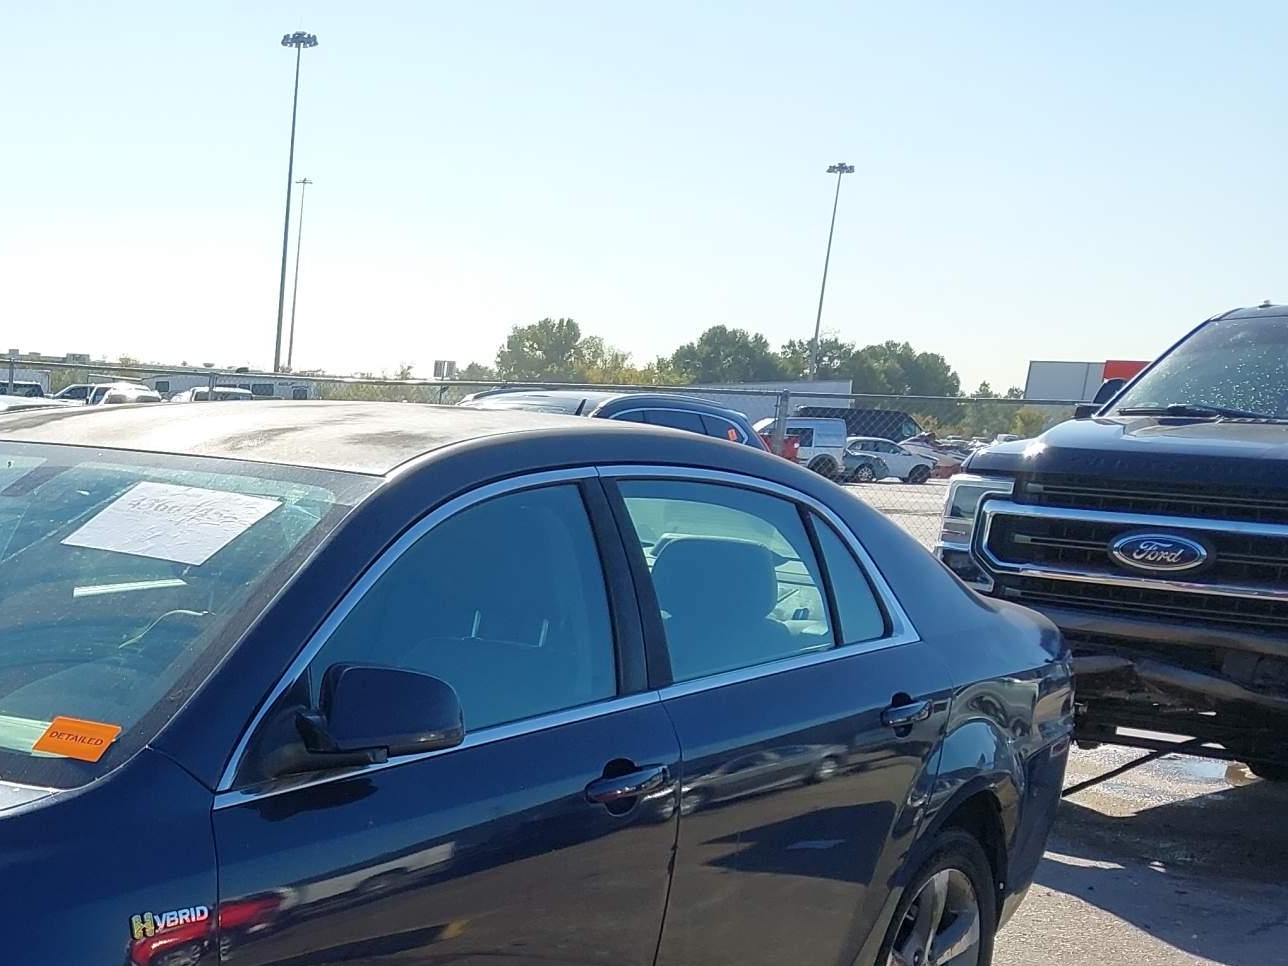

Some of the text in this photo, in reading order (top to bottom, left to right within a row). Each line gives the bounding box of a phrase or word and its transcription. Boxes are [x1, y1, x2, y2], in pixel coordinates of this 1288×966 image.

[1132, 540, 1185, 563] Ford
[49, 730, 104, 746] DETAILED
[131, 905, 209, 940] HYBRID
